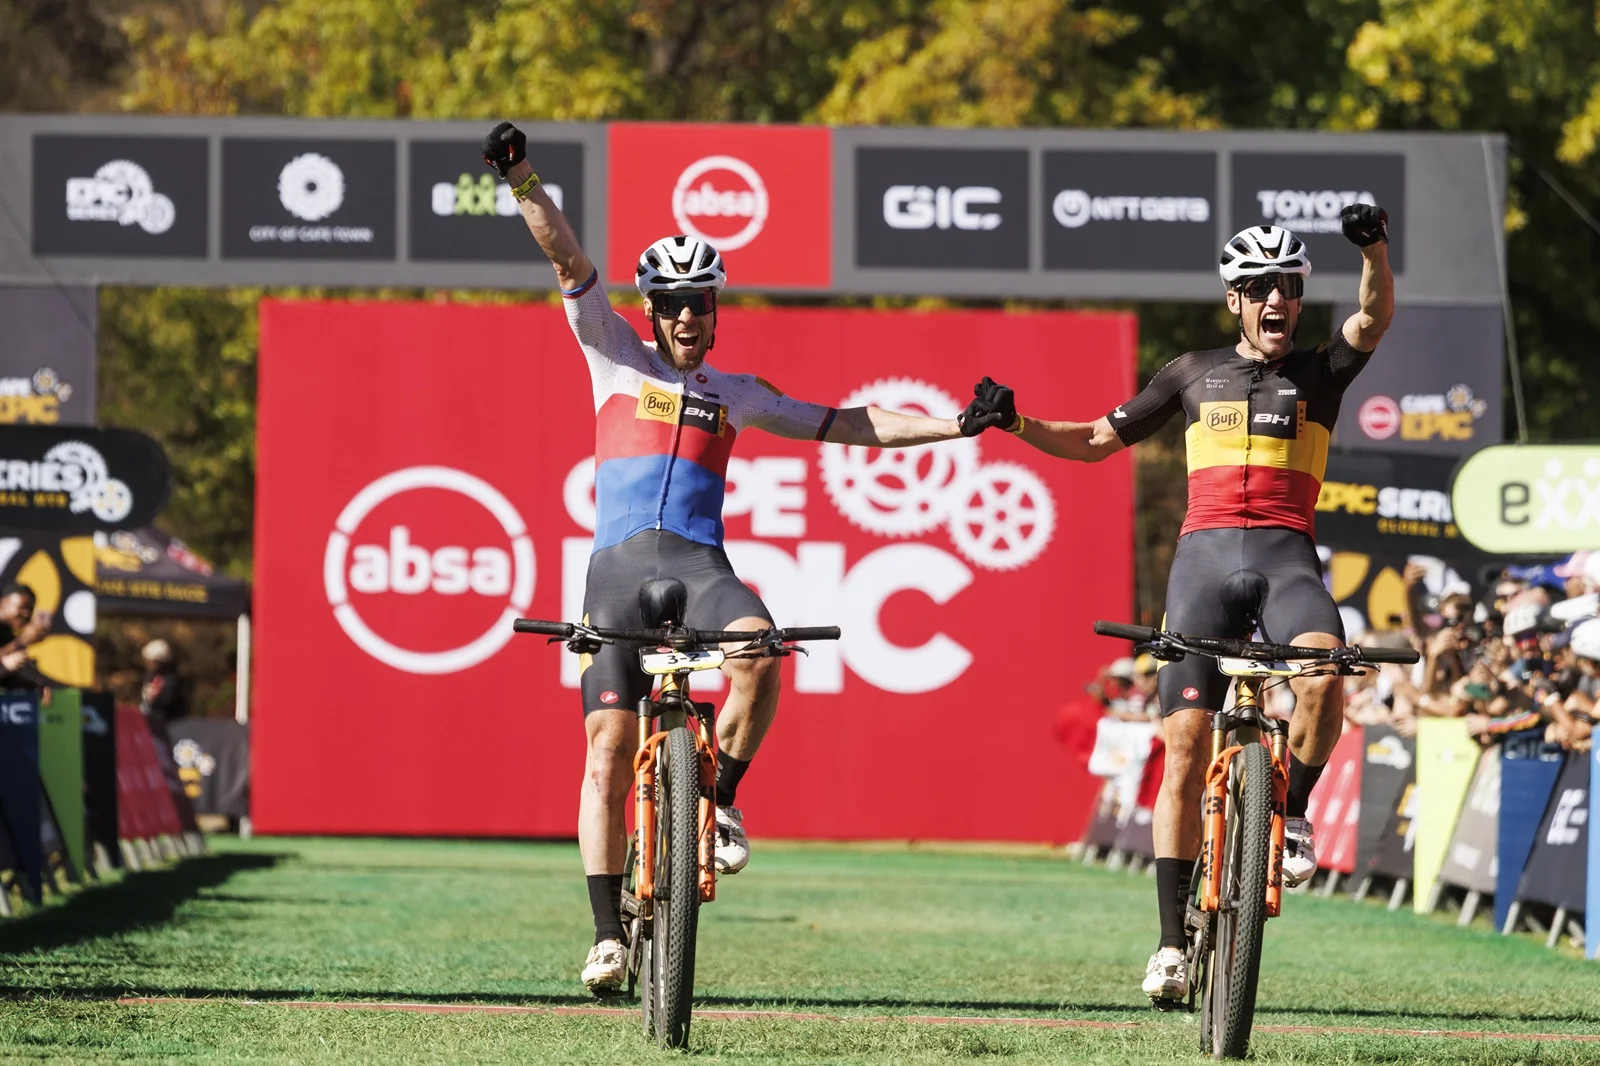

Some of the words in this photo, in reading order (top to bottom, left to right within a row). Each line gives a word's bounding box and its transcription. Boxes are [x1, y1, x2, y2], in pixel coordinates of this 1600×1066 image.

[684, 181, 755, 216] absa
[883, 185, 1002, 229] GIC
[648, 396, 671, 413] Buff
[684, 407, 714, 421] BH
[1210, 412, 1238, 427] Buff
[1253, 413, 1290, 426] BH
[1401, 412, 1473, 441] EPIC
[350, 525, 511, 596] absa
[667, 653, 701, 665] 3-2
